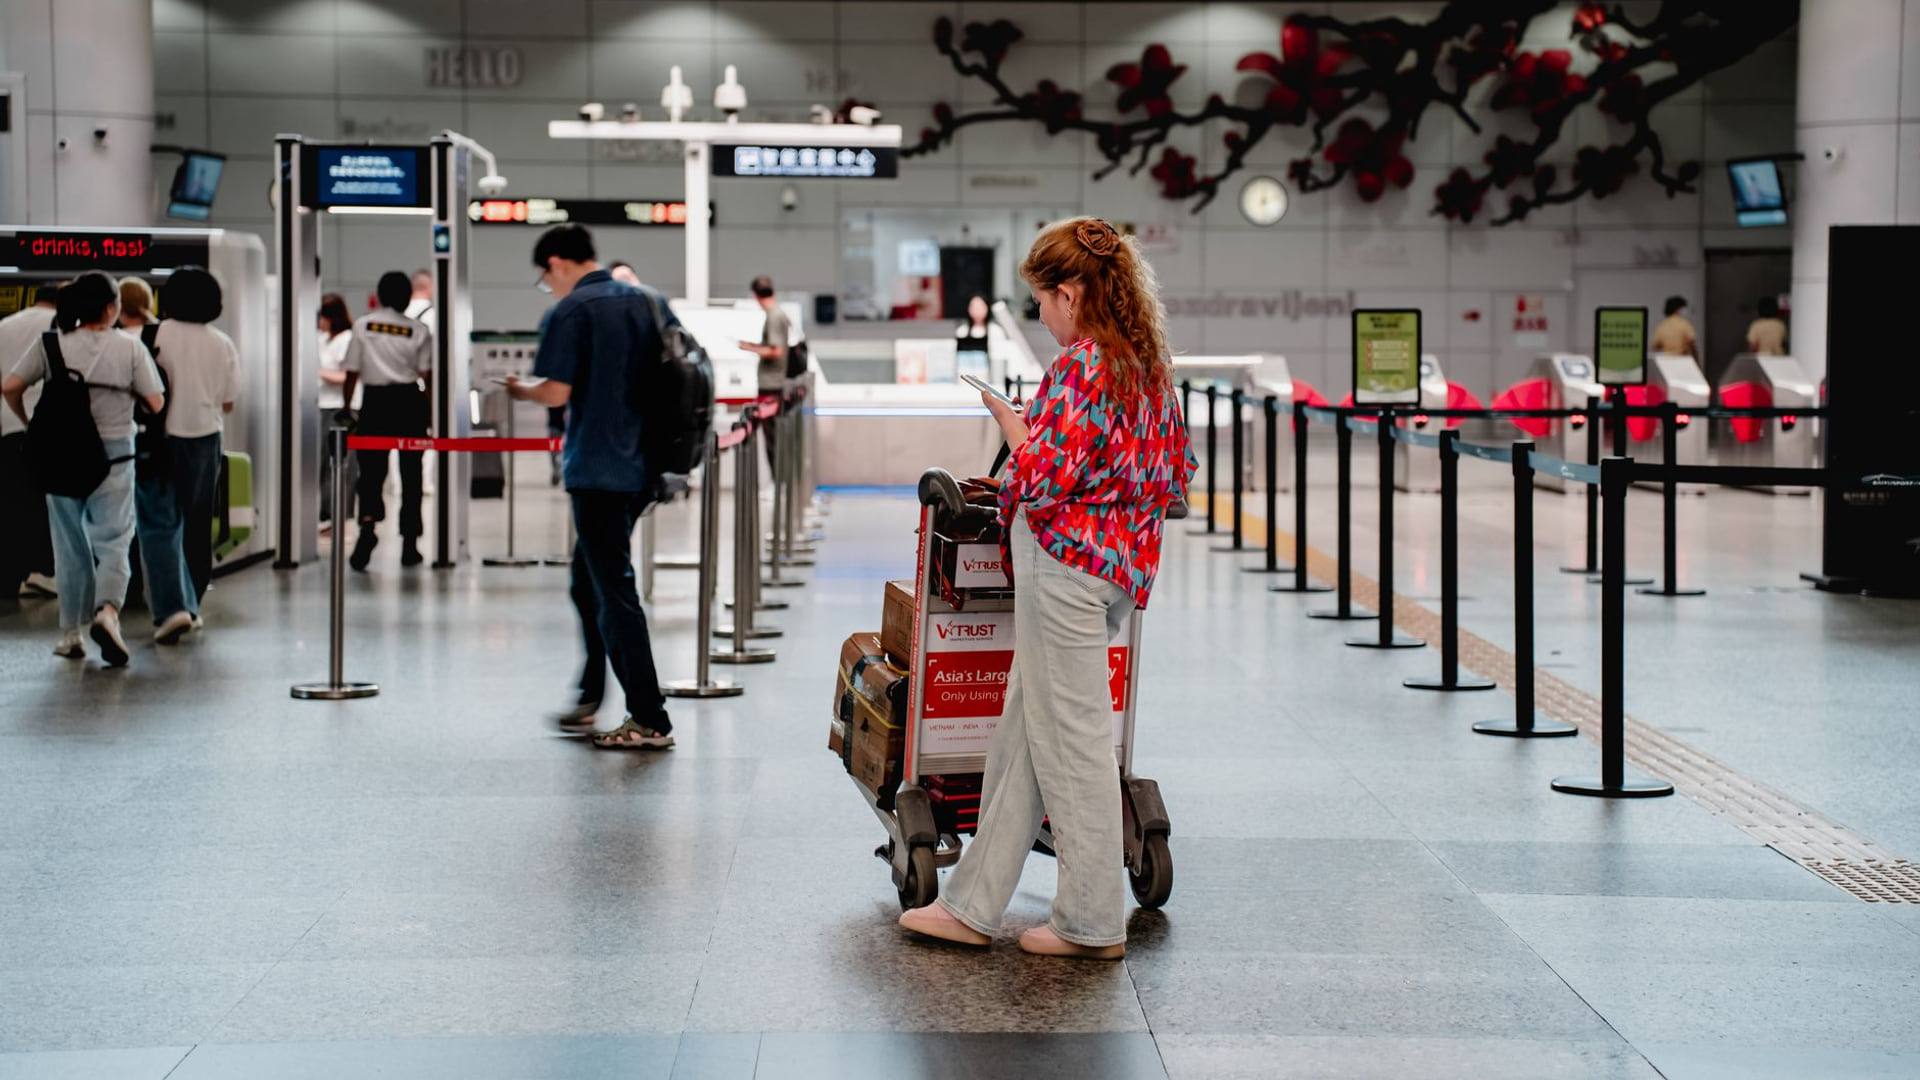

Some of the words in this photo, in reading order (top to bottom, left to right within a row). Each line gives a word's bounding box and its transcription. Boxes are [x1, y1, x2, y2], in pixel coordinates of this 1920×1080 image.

[424, 46, 525, 89] HELLO
[31, 237, 98, 259] drinks,
[934, 670, 973, 683] Asia's
[941, 691, 967, 703] Only
[969, 690, 999, 702] Using
